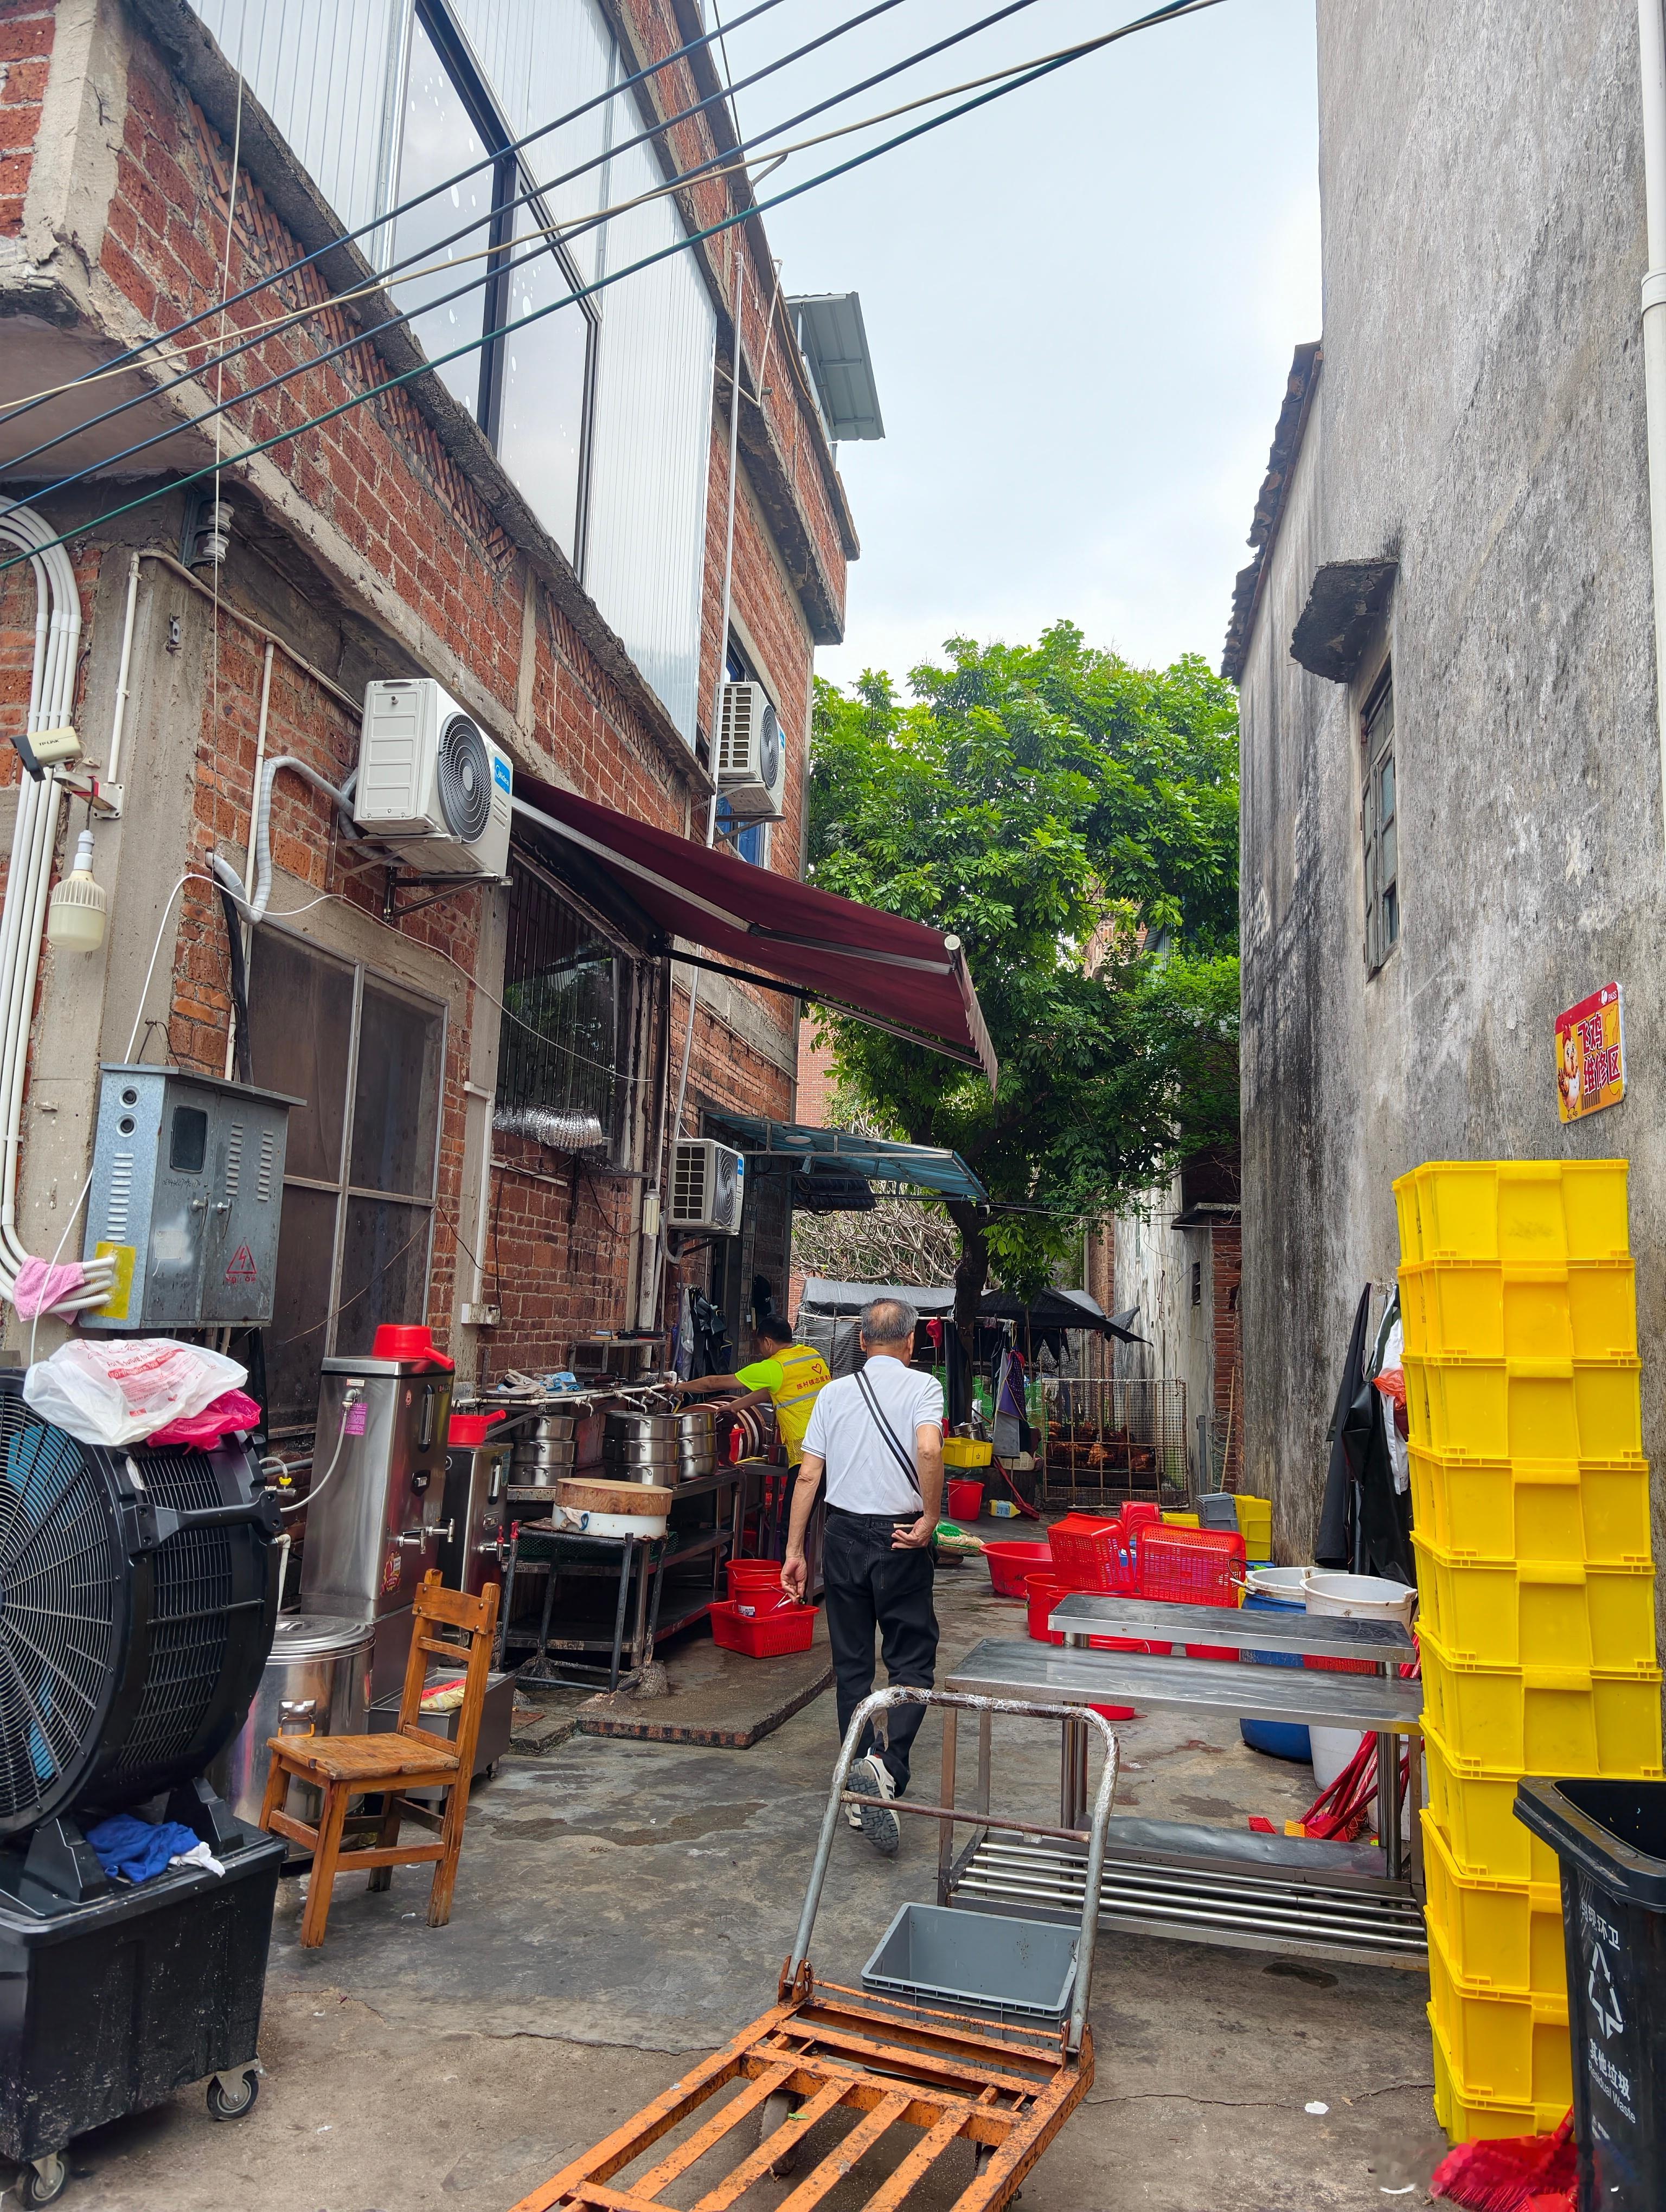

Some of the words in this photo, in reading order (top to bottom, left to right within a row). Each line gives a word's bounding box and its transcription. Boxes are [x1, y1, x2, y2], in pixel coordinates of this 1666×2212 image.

[495, 764, 509, 787] Midea
[1608, 990, 1617, 1003] PASS
[1577, 1011, 1603, 1057] 飞鸡
[1583, 1044, 1620, 1095] 维修区
[1588, 2059, 1612, 2099] Residual
[1612, 2090, 1636, 2124] Waste
[1589, 2039, 1631, 2101] 其他垃圾
